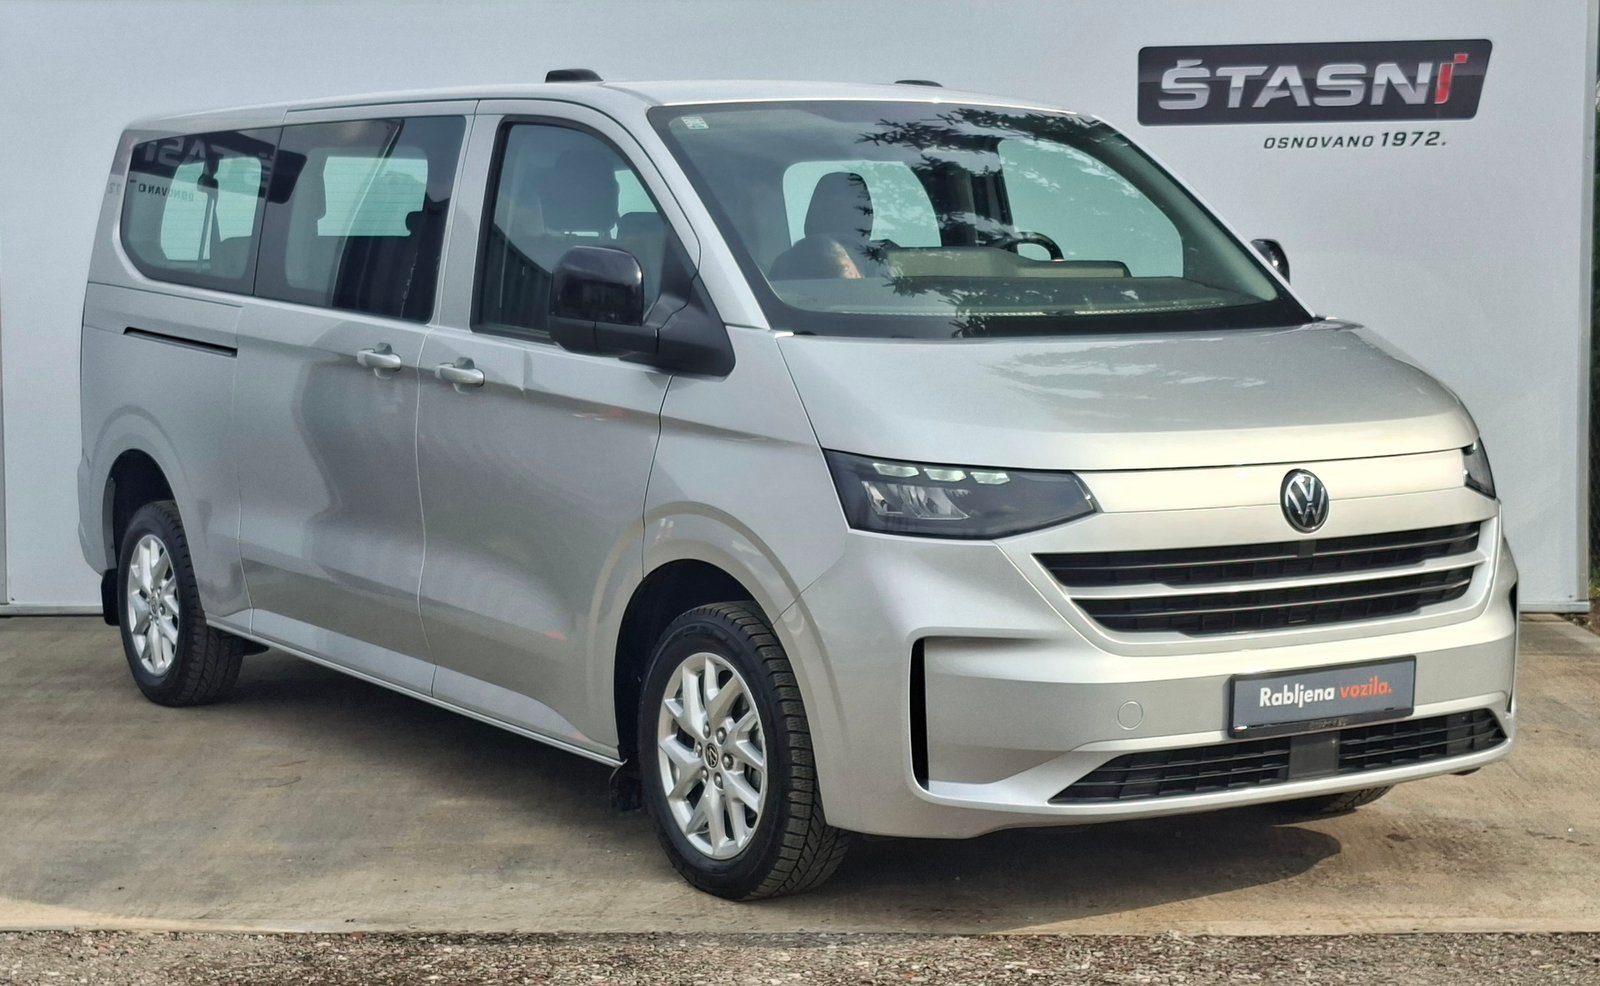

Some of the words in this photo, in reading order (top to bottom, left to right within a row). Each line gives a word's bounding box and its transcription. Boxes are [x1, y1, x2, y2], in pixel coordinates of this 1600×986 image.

[1263, 135, 1374, 149] OSNOVANO
[1380, 131, 1447, 148] 1972.
[1259, 683, 1335, 708] Rabljena
[1340, 676, 1393, 699] vozila.
